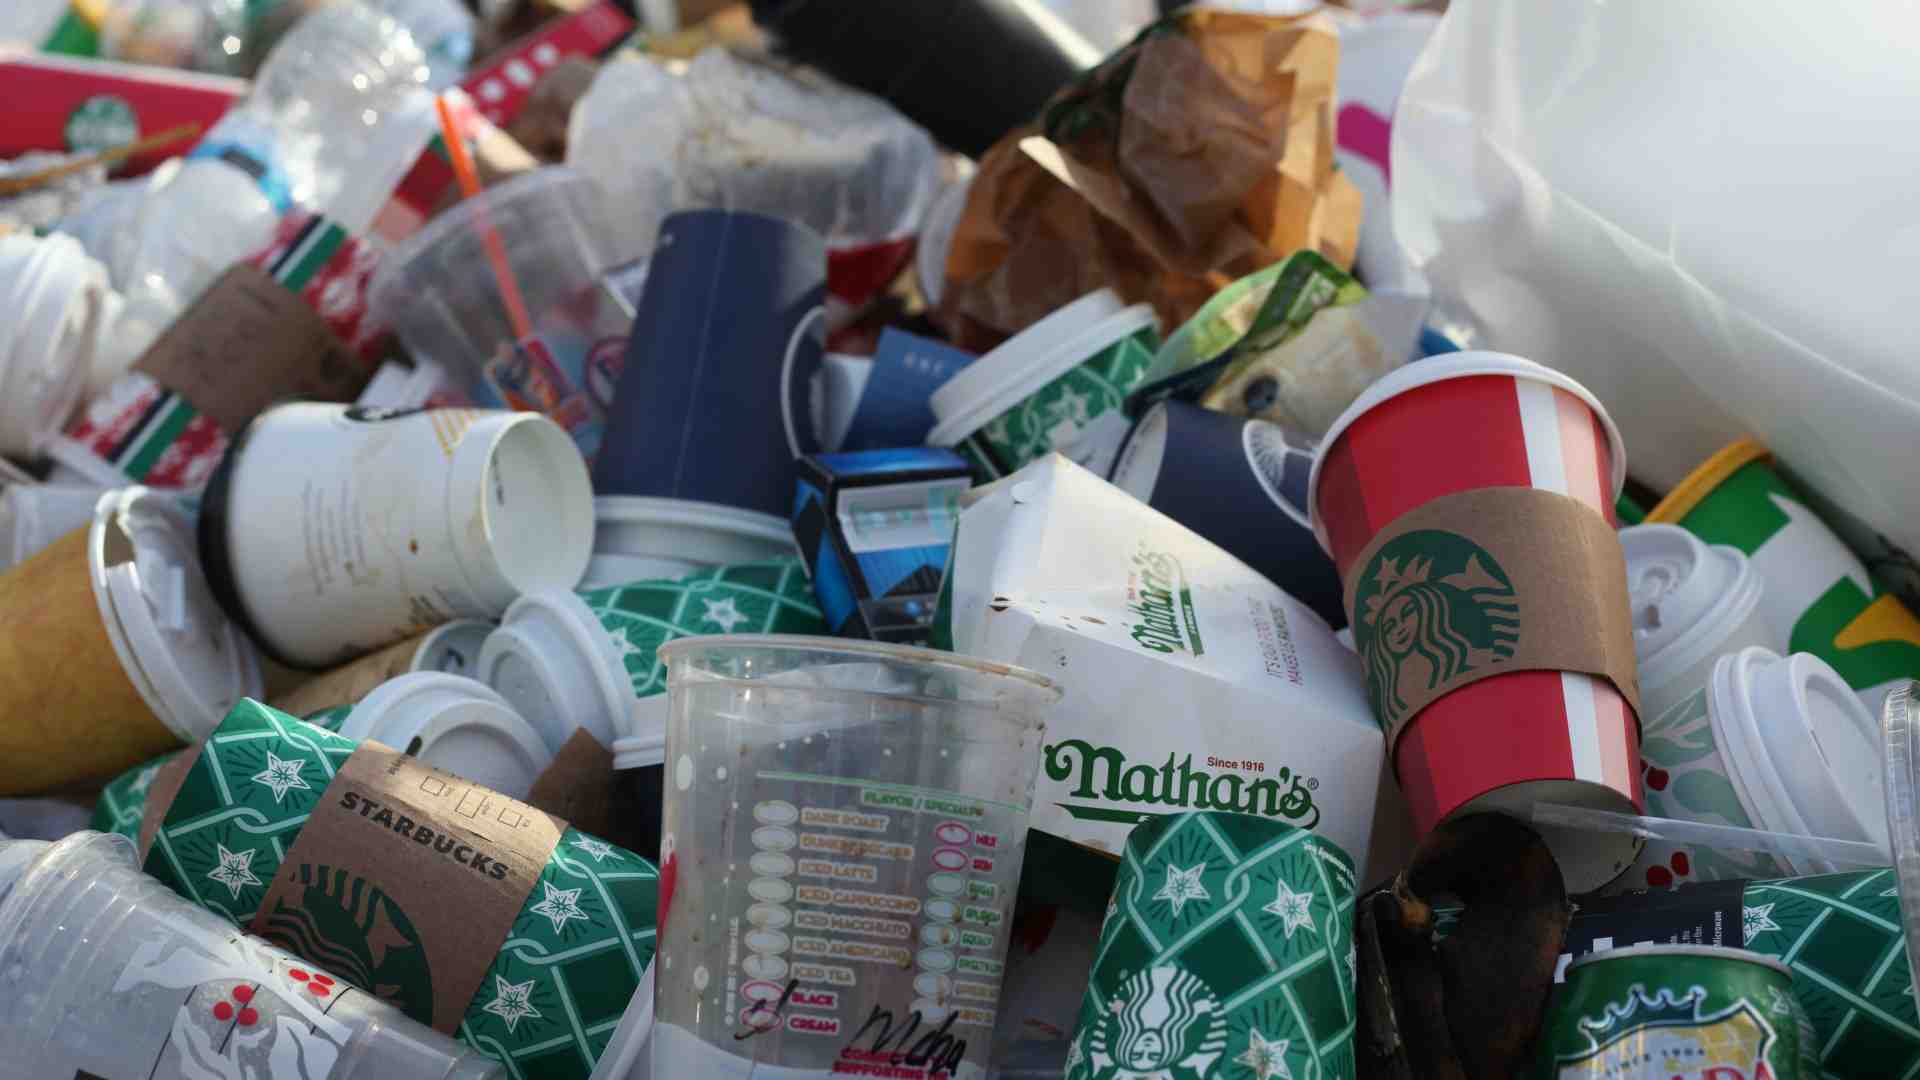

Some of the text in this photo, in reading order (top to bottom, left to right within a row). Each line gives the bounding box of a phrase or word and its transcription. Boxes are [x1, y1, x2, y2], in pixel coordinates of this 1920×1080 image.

[1207, 756, 1265, 772] Since 1916
[1043, 738, 1320, 830] Nathan's
[340, 791, 509, 880] STARBUCKS
[791, 990, 836, 1009] BLACK
[788, 1016, 839, 1034] CREAM
